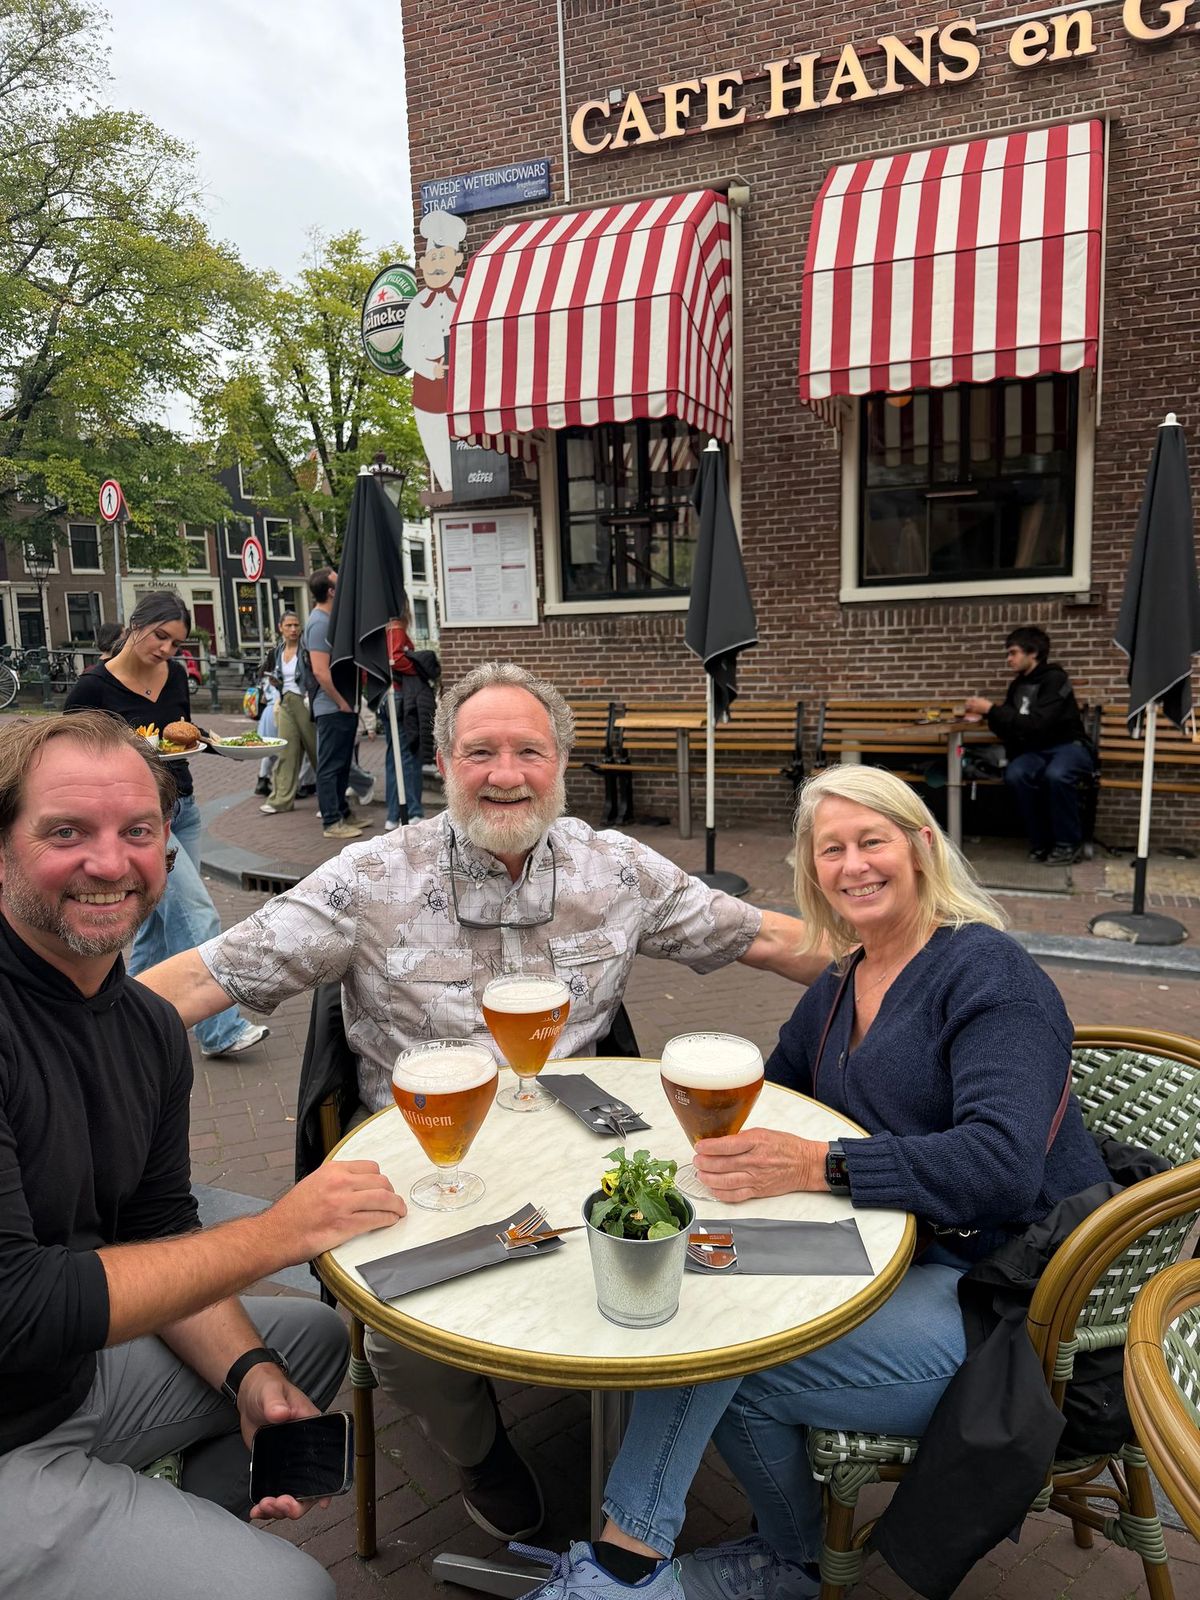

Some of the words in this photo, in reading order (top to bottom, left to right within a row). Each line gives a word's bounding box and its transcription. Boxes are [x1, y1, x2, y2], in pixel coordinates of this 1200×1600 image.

[569, 69, 748, 156] CAFE
[763, 17, 982, 120] HANS
[1007, 7, 1098, 67] en
[1122, 0, 1200, 41] G
[422, 178, 461, 199] TWEEDE
[463, 162, 546, 190] WETERINGDWARS
[423, 195, 458, 214] STRAAT
[363, 306, 406, 333] eineke
